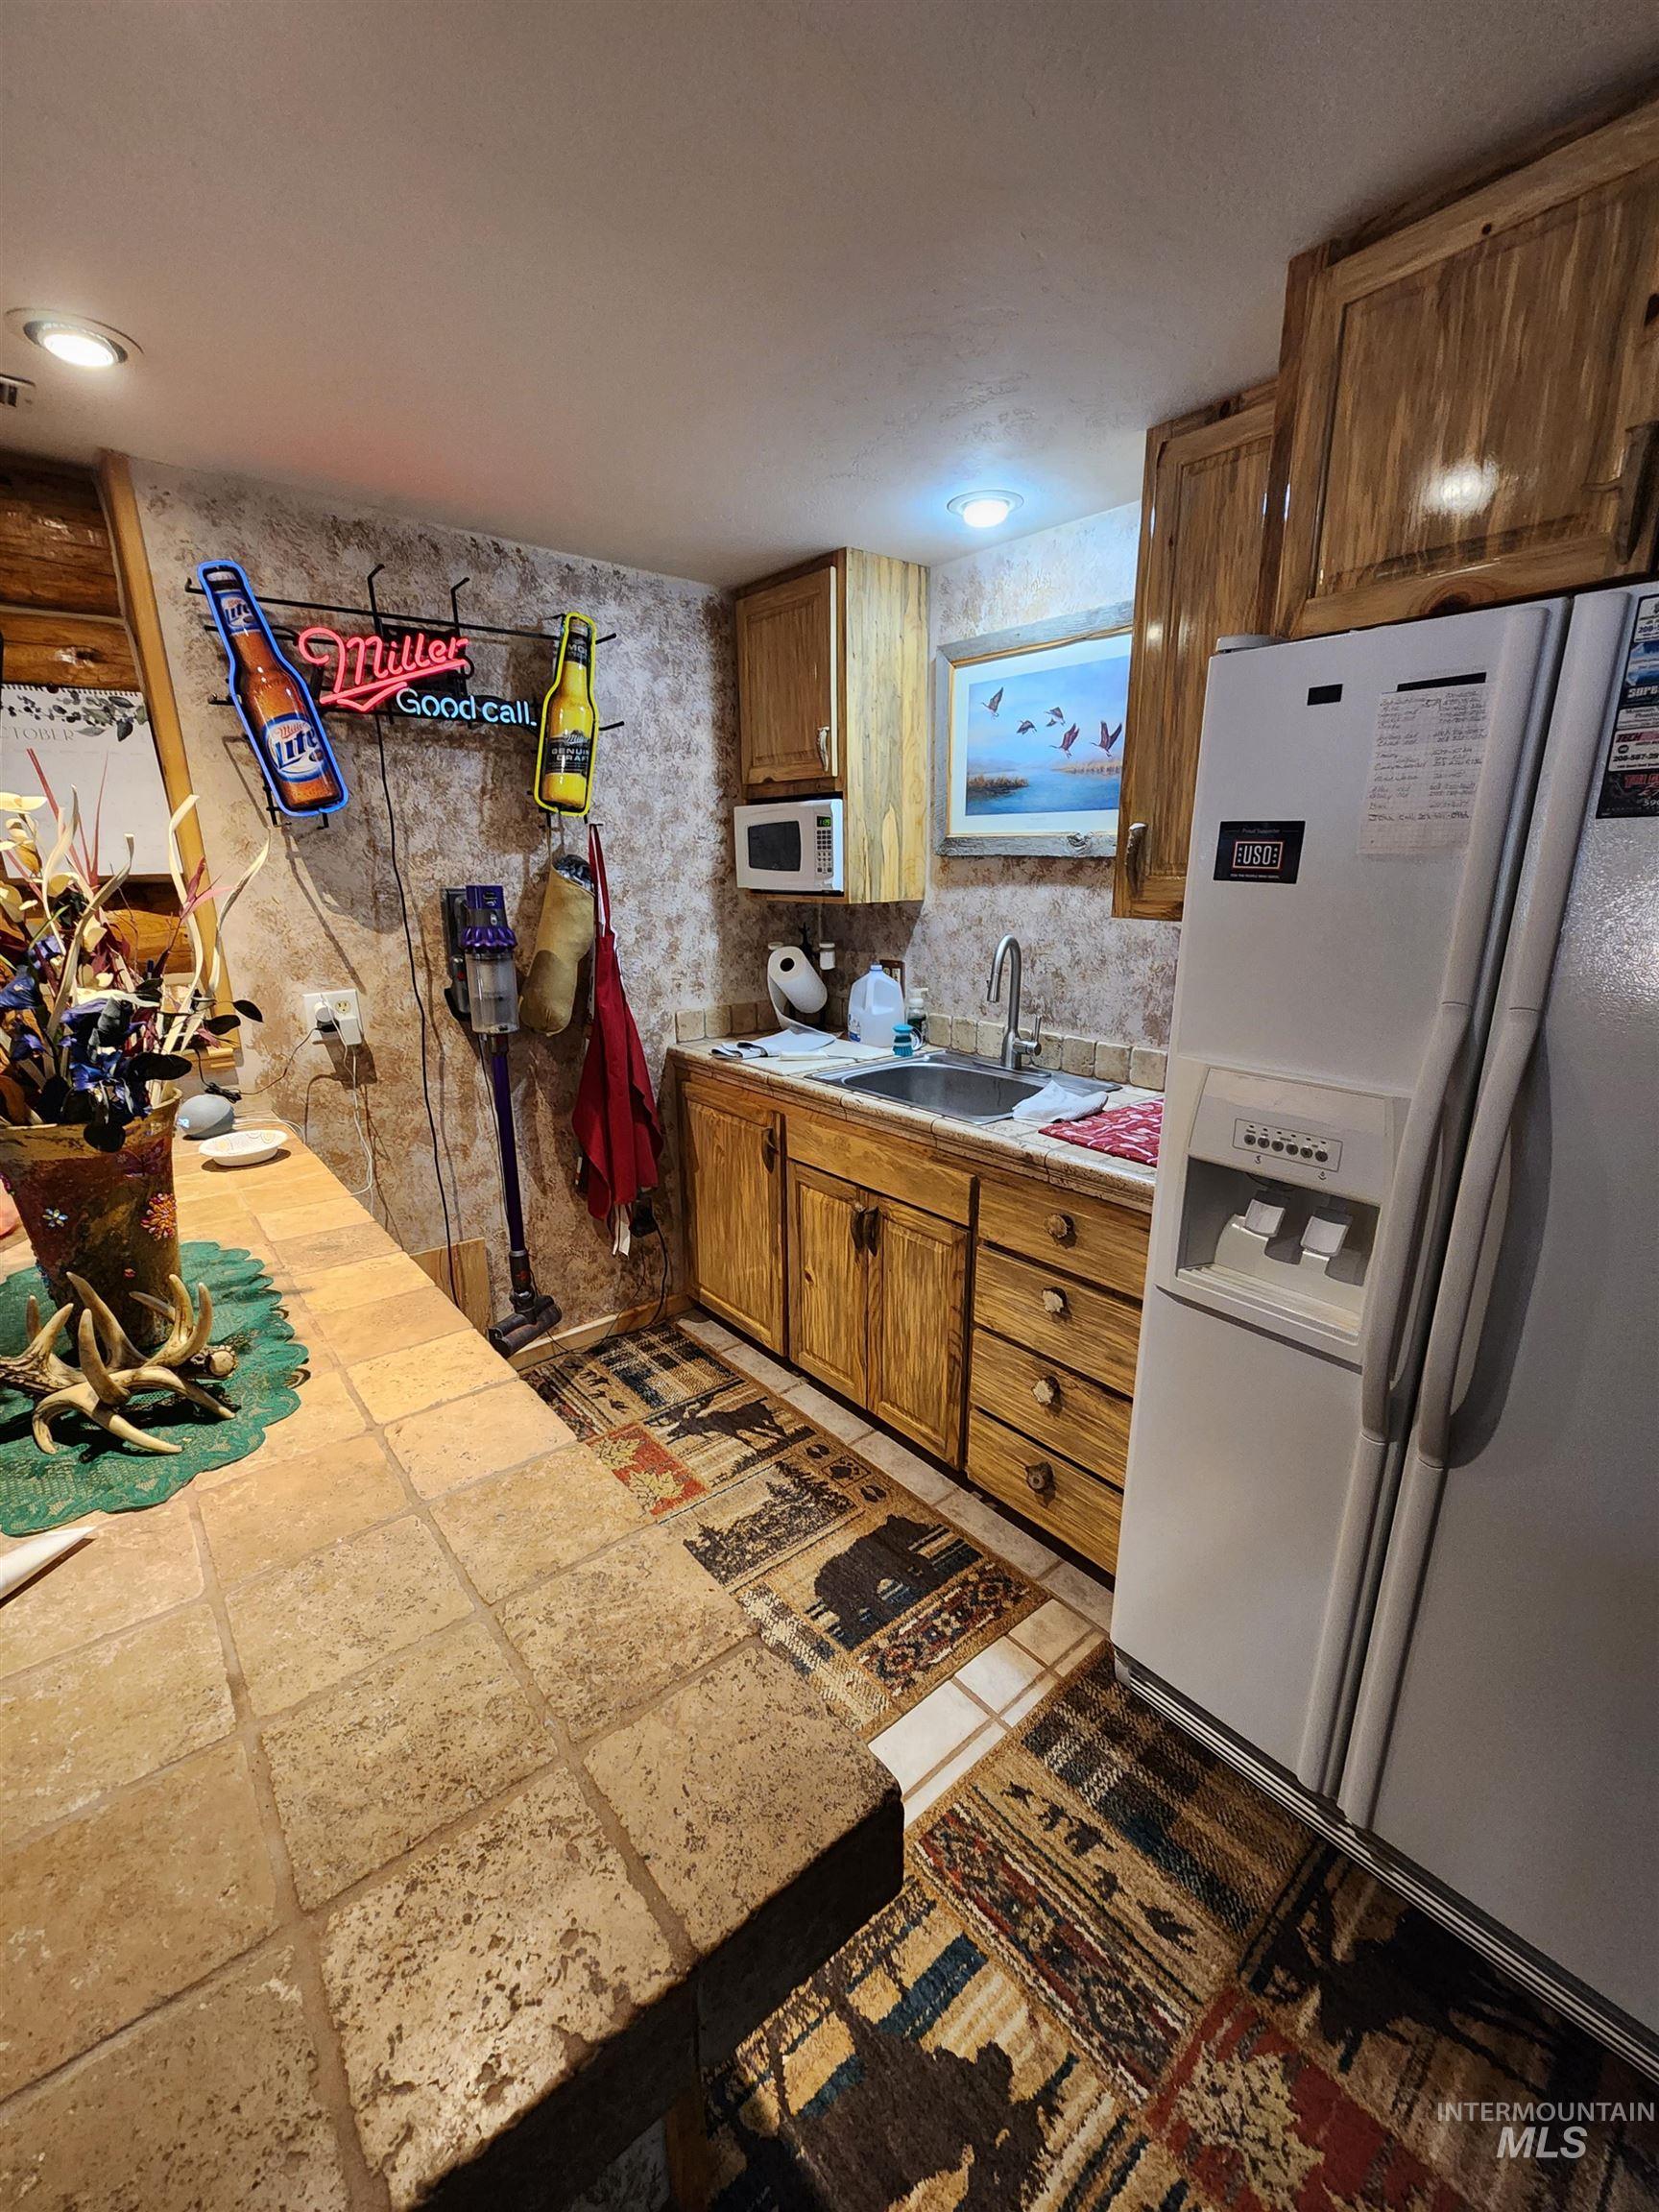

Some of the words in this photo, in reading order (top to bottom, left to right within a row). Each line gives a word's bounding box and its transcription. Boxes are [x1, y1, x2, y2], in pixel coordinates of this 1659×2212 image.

[298, 626, 469, 695] Miller
[396, 687, 476, 720] Good
[481, 700, 538, 727] call.
[276, 729, 318, 769] Lite
[1242, 845, 1272, 865] USO
